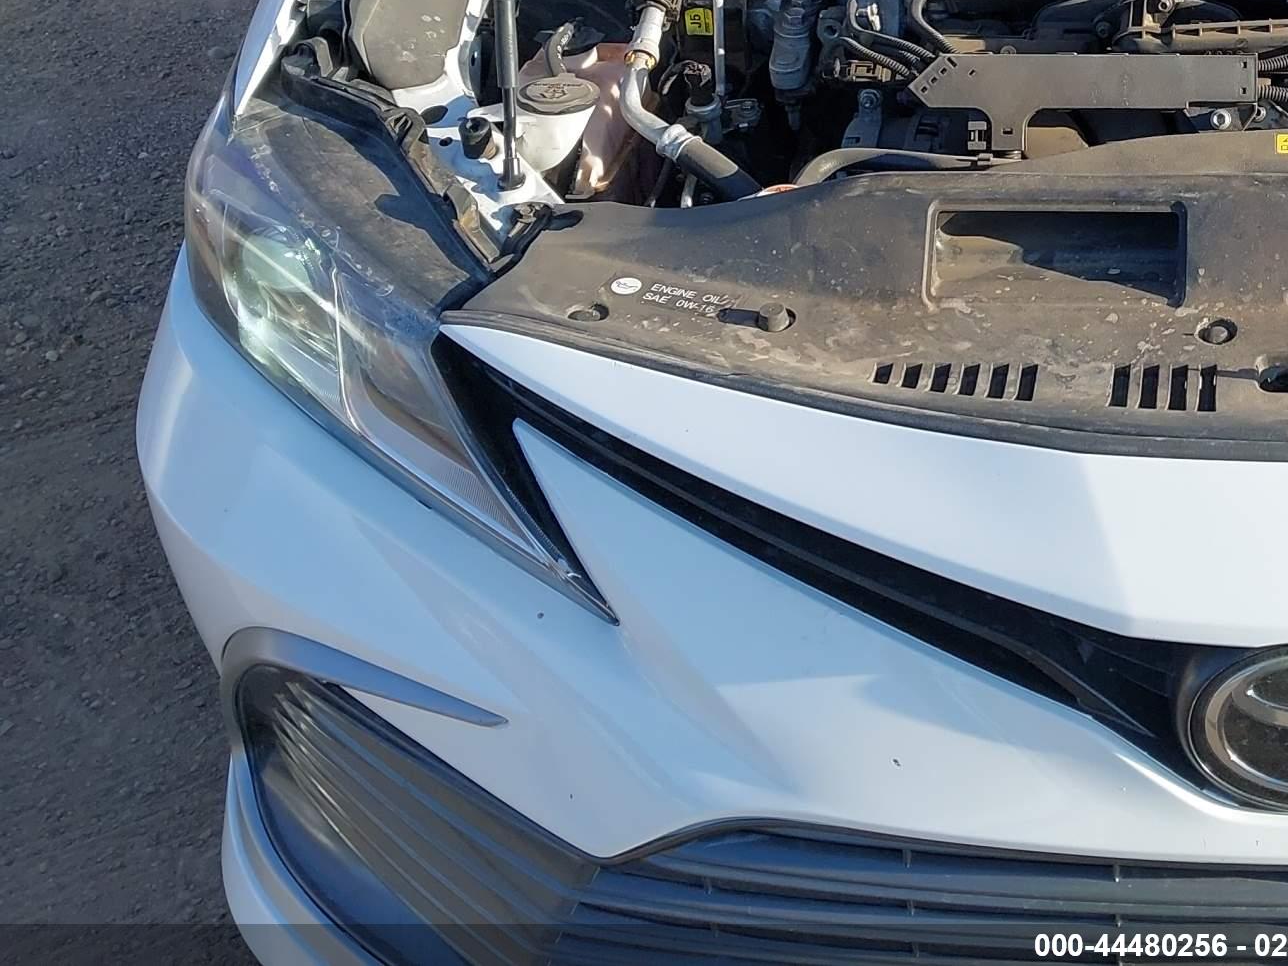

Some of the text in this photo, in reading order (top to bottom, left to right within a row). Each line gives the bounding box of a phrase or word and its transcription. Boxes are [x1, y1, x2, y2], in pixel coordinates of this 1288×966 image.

[643, 292, 672, 304] SAE
[651, 283, 722, 305] ENGINE OIL
